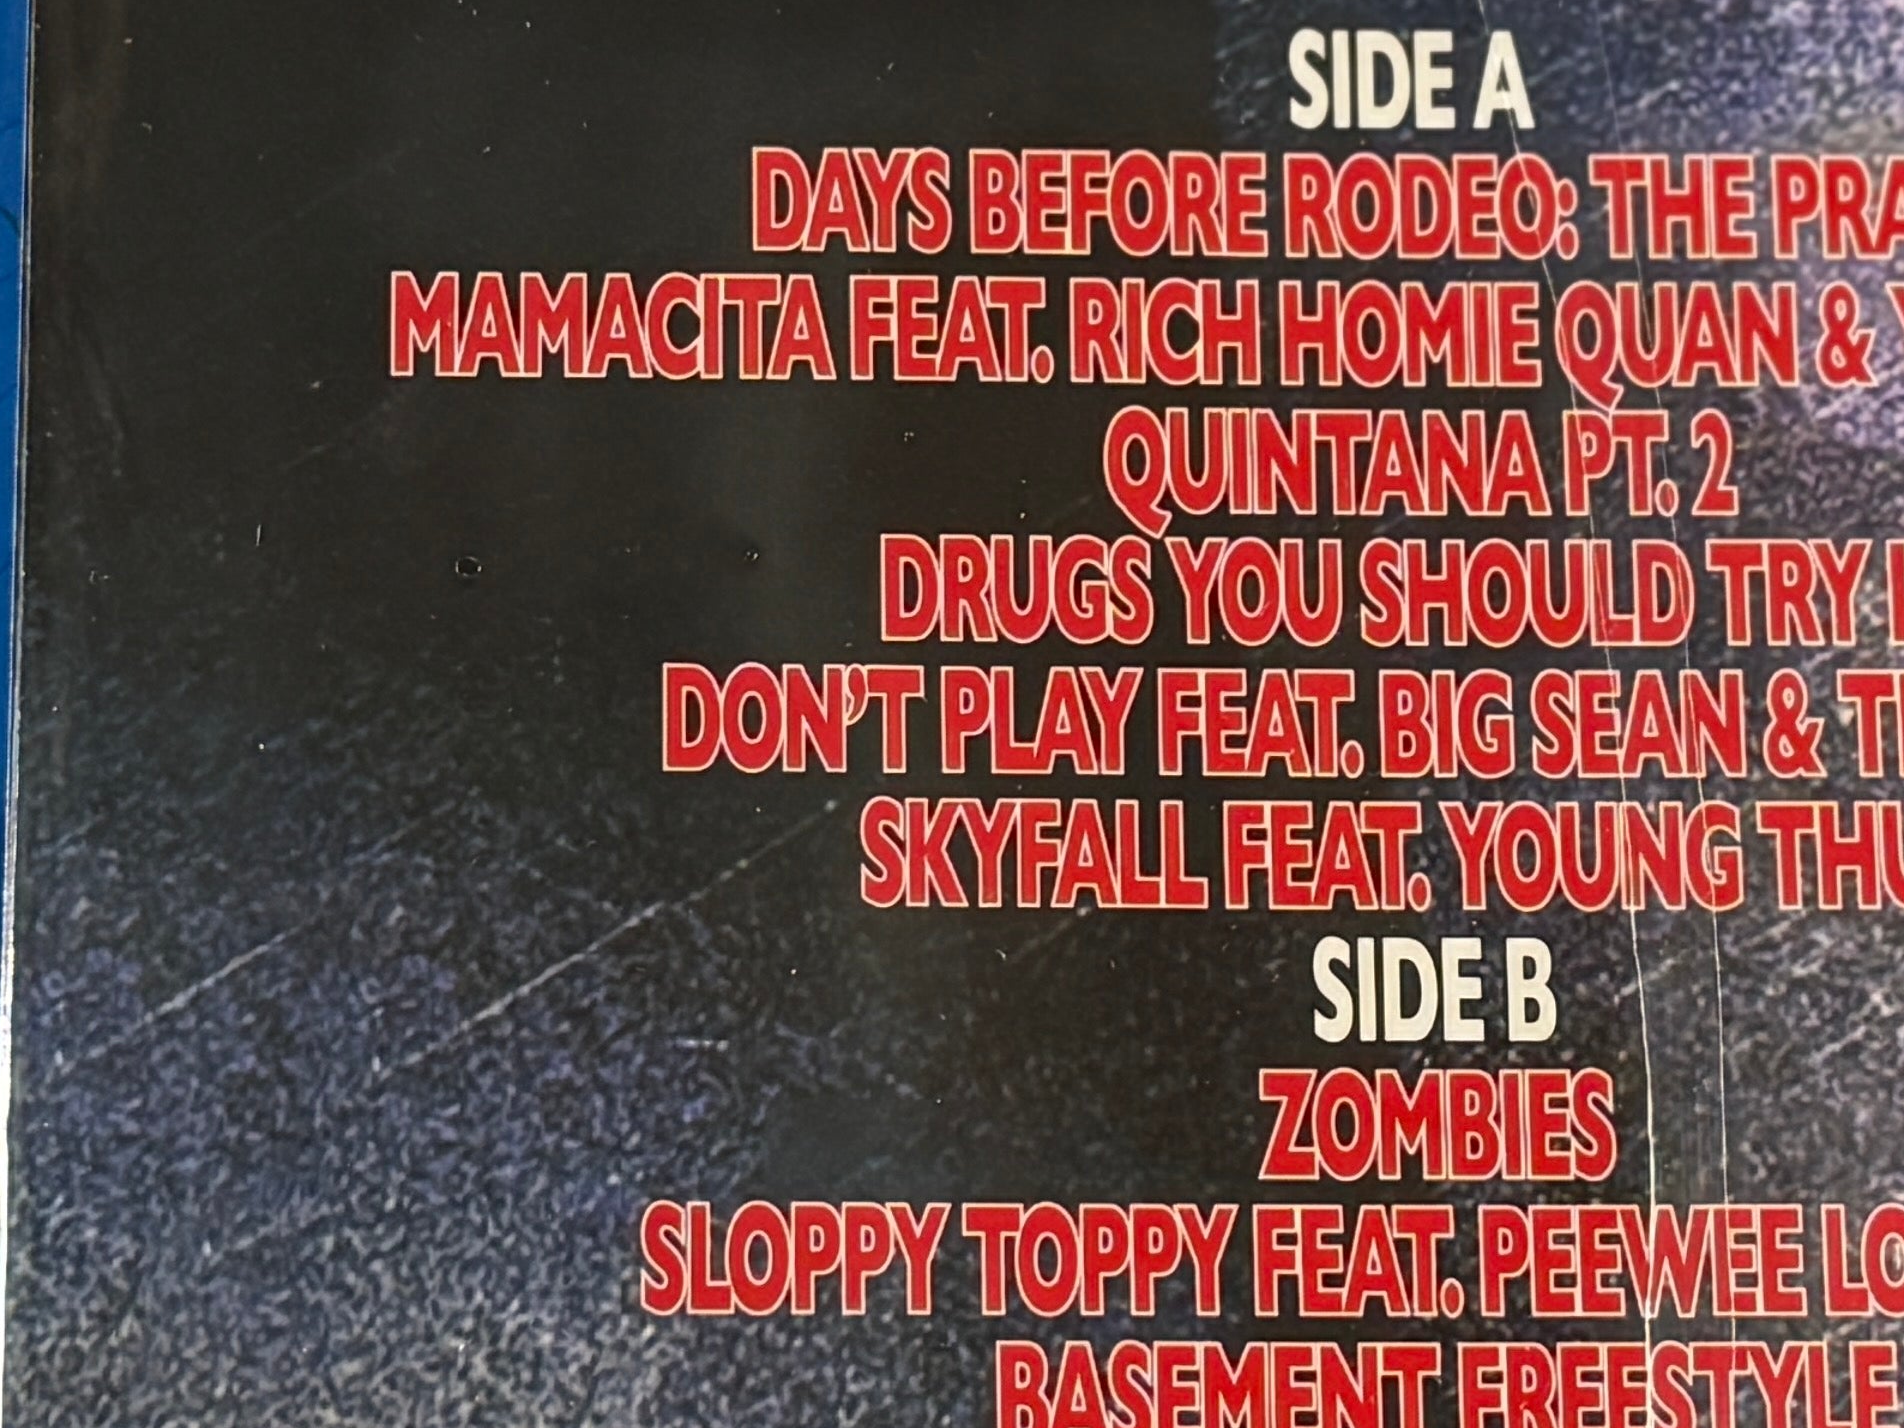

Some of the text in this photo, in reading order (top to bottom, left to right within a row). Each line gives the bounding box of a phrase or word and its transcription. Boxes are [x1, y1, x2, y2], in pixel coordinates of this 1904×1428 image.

[1288, 29, 1535, 130] SIDE A
[751, 146, 951, 253] DAYS
[970, 149, 1268, 257] BEFORE
[1284, 152, 1578, 260] RODEO:
[1589, 154, 1756, 260] THE
[390, 271, 836, 380] MAMACITA
[849, 274, 1055, 383] FEAT.
[1069, 277, 1261, 385] RICH
[1279, 280, 1540, 388] HOMIE
[1556, 280, 1798, 410] QUAN
[1817, 281, 1876, 388] &
[1103, 405, 1739, 536] QUINTANA PT. 2
[880, 534, 1155, 644] DRUGS
[1166, 536, 1343, 647] YOU
[1361, 538, 1695, 648] SHOULD
[1706, 539, 1869, 647] TRY
[941, 666, 1143, 776] PLAY
[1157, 667, 1364, 778] FEAT.
[1378, 669, 1515, 779] BIG
[1530, 669, 1747, 779] SEAN
[1763, 668, 1828, 779] &
[859, 797, 1208, 909] SKYFALL
[1222, 800, 1432, 913] FEAT.
[1439, 799, 1745, 912] YOUNG
[1313, 935, 1558, 1043] SIDE B
[1258, 1067, 1617, 1181] ZOMBIES
[640, 1200, 951, 1316] SLOPPY
[961, 1201, 1238, 1317] TOPPY
[1253, 1204, 1465, 1318] FEAT.
[1479, 1203, 1808, 1318] PEEWEE
